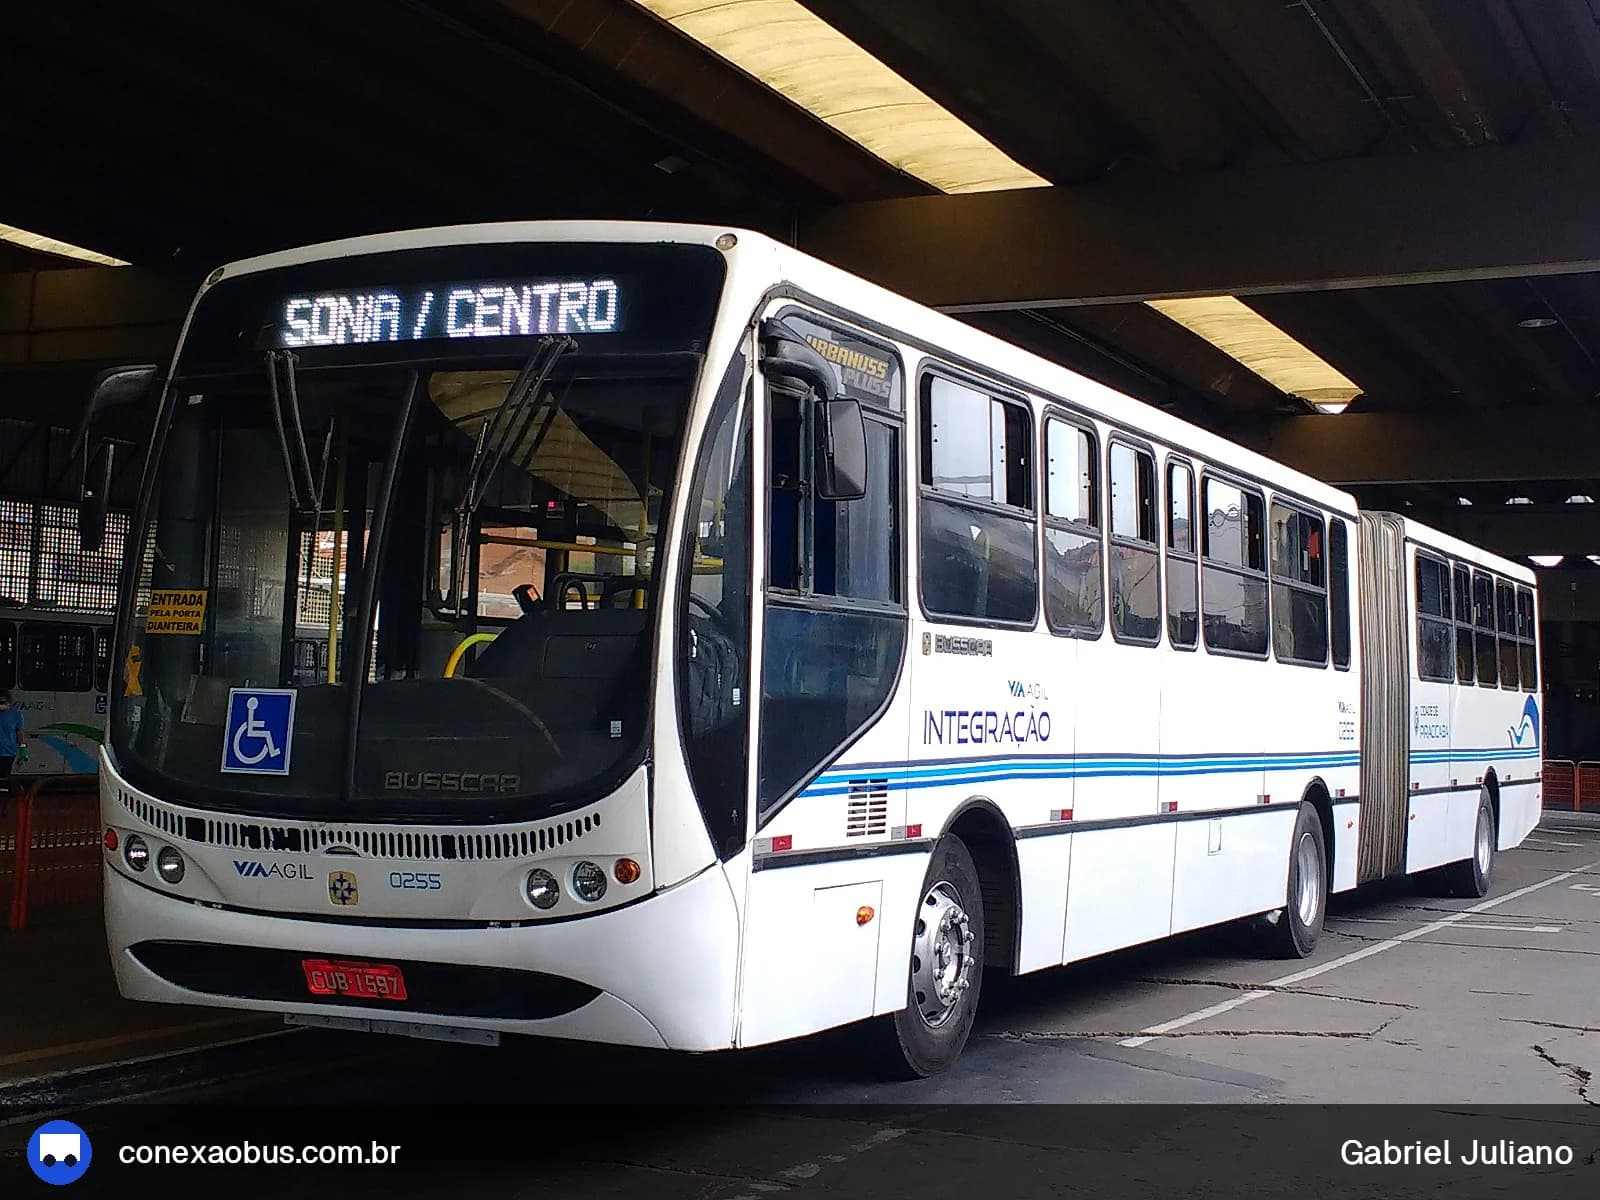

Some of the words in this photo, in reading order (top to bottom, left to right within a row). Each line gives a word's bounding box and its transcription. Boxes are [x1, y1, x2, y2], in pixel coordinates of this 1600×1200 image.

[284, 294, 400, 346] SONIA
[447, 280, 617, 338] CENTRO
[806, 335, 889, 380] URBANUSS
[841, 366, 891, 399] PLUSS
[151, 593, 203, 606] ENTRADA
[151, 609, 171, 617] PELA
[174, 609, 201, 618] PORTA
[147, 621, 200, 631] DIANTEIRA
[935, 633, 993, 657] BUSSCAR
[923, 704, 1051, 749] INTEGRAÇÃO
[384, 771, 521, 792] BUSSCAR
[389, 871, 442, 890] 0255
